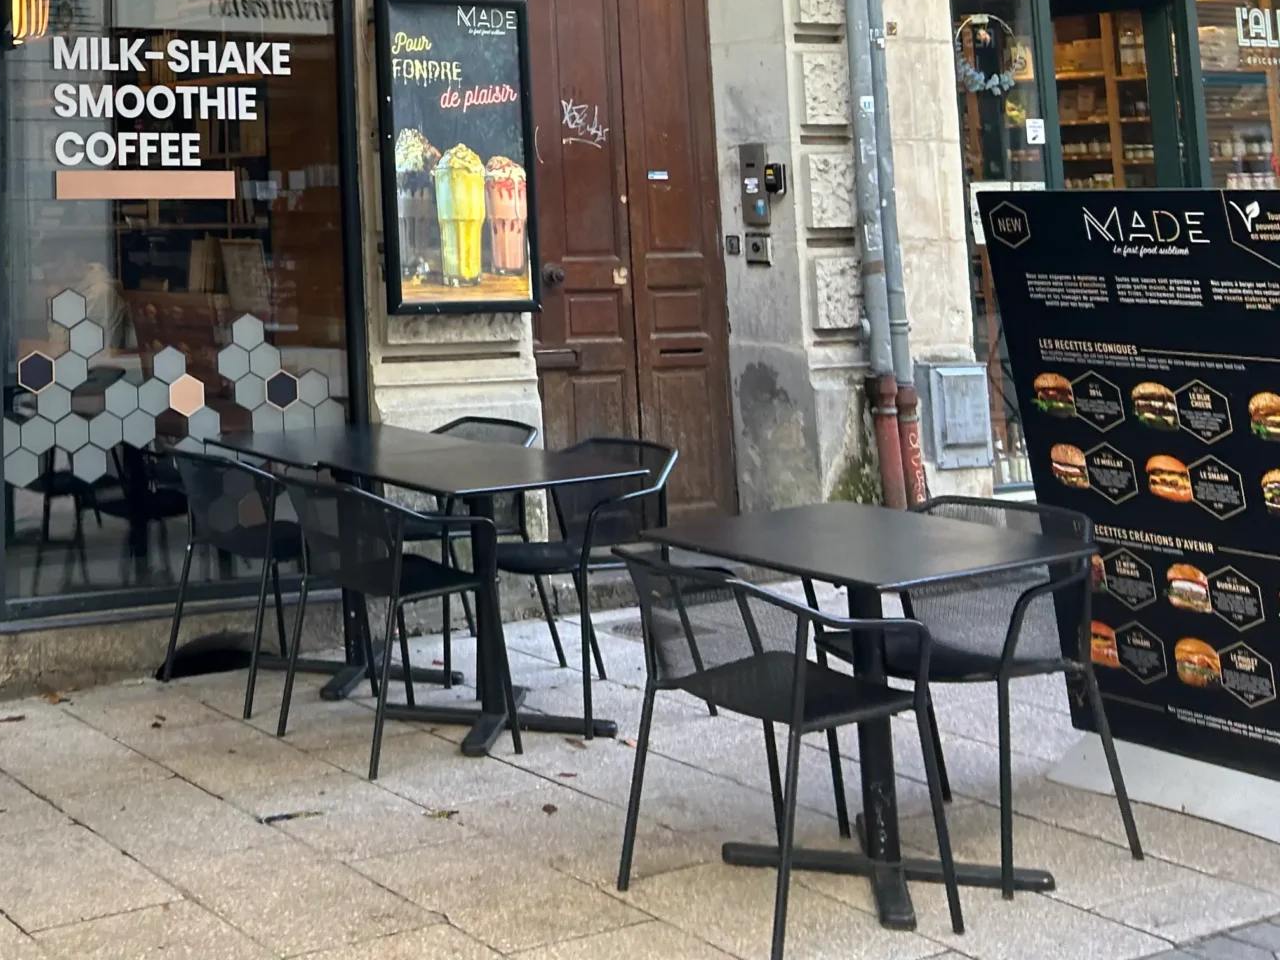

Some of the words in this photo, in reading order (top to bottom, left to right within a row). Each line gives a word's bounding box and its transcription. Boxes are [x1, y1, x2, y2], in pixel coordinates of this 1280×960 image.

[456, 5, 517, 30] MADE
[52, 35, 292, 76] MILK-SHAKE
[391, 31, 433, 55] Pour
[391, 58, 464, 87] FONDRE
[53, 82, 258, 121] SMOOTHIE
[440, 88, 462, 109] de
[462, 83, 518, 114] plaisir
[54, 130, 202, 167] COFFEE
[997, 217, 1022, 233] NEW
[1082, 206, 1211, 244] MADE
[1113, 244, 1123, 254] Le
[1122, 245, 1139, 256] fast
[1139, 245, 1158, 258] food
[1038, 338, 1053, 349] LES
[1054, 339, 1093, 352] RECETTES
[1094, 342, 1138, 355] ICONIQUES
[1094, 524, 1128, 539] ECETTES
[1129, 529, 1174, 548] CRÉATIONS
[1175, 538, 1215, 555] D'AVENIR
